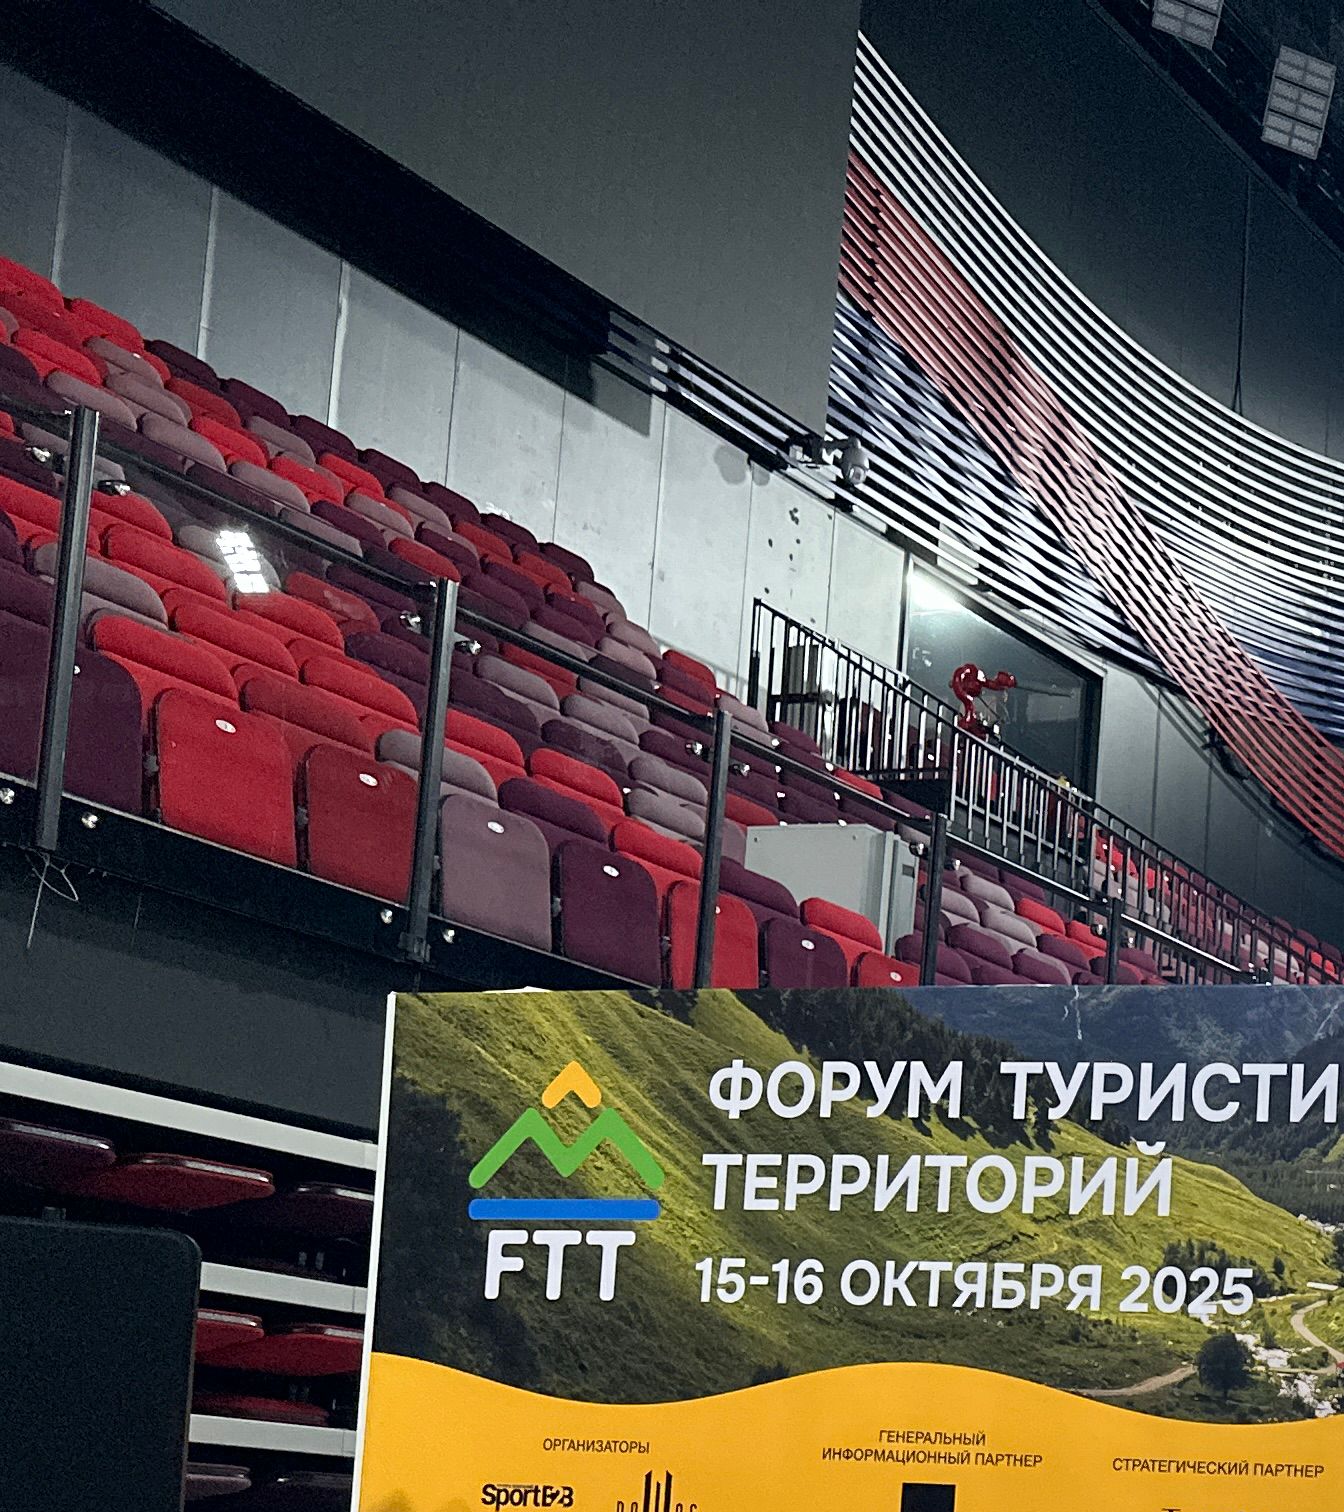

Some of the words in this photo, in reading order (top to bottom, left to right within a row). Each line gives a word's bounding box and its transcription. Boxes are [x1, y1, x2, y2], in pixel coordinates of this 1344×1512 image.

[707, 1058, 965, 1122] ФОРУМ
[702, 1141, 1174, 1217] ТЕРРИТОРИЙ
[483, 1230, 634, 1301] FTT
[695, 1257, 824, 1306] 15-16
[840, 1260, 1104, 1312] ОКТЯБРЯ
[1120, 1264, 1255, 1317] 2025
[543, 1438, 650, 1454] ОРГАНИЗАТОРЫ
[822, 1446, 970, 1467] ИНФОРМАЦИОННЫЙ
[974, 1452, 1043, 1468] ПАРТНЕР
[878, 1430, 986, 1447] ГЕНЕРАЛЬНЫЙ
[1112, 1457, 1249, 1476] СТРАТЕГИЧЕСКИЙ
[1253, 1462, 1325, 1479] ПАРТНЕР
